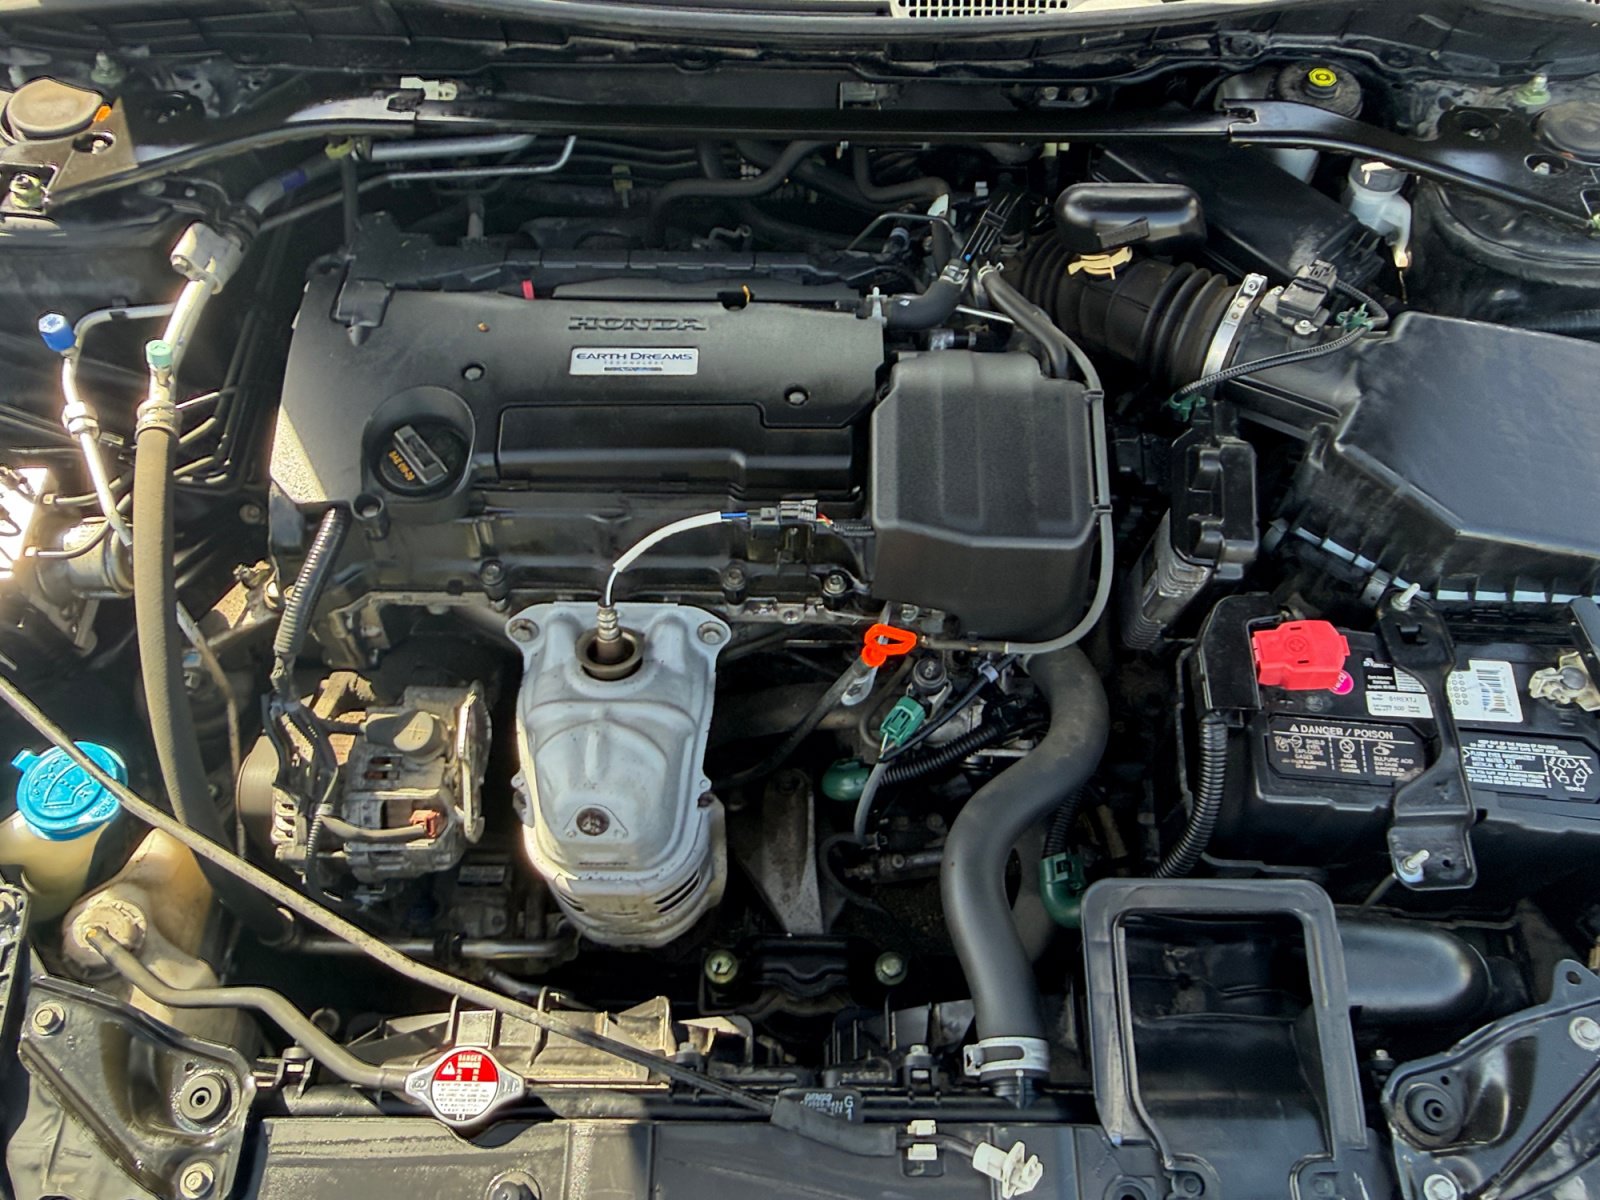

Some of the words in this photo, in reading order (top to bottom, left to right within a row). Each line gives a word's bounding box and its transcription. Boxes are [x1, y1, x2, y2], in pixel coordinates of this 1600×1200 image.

[568, 316, 707, 331] HONDA
[576, 352, 627, 360] EARTH
[630, 352, 692, 360] DREAMS
[1300, 725, 1344, 736] DANGER
[1354, 729, 1393, 740] POISON
